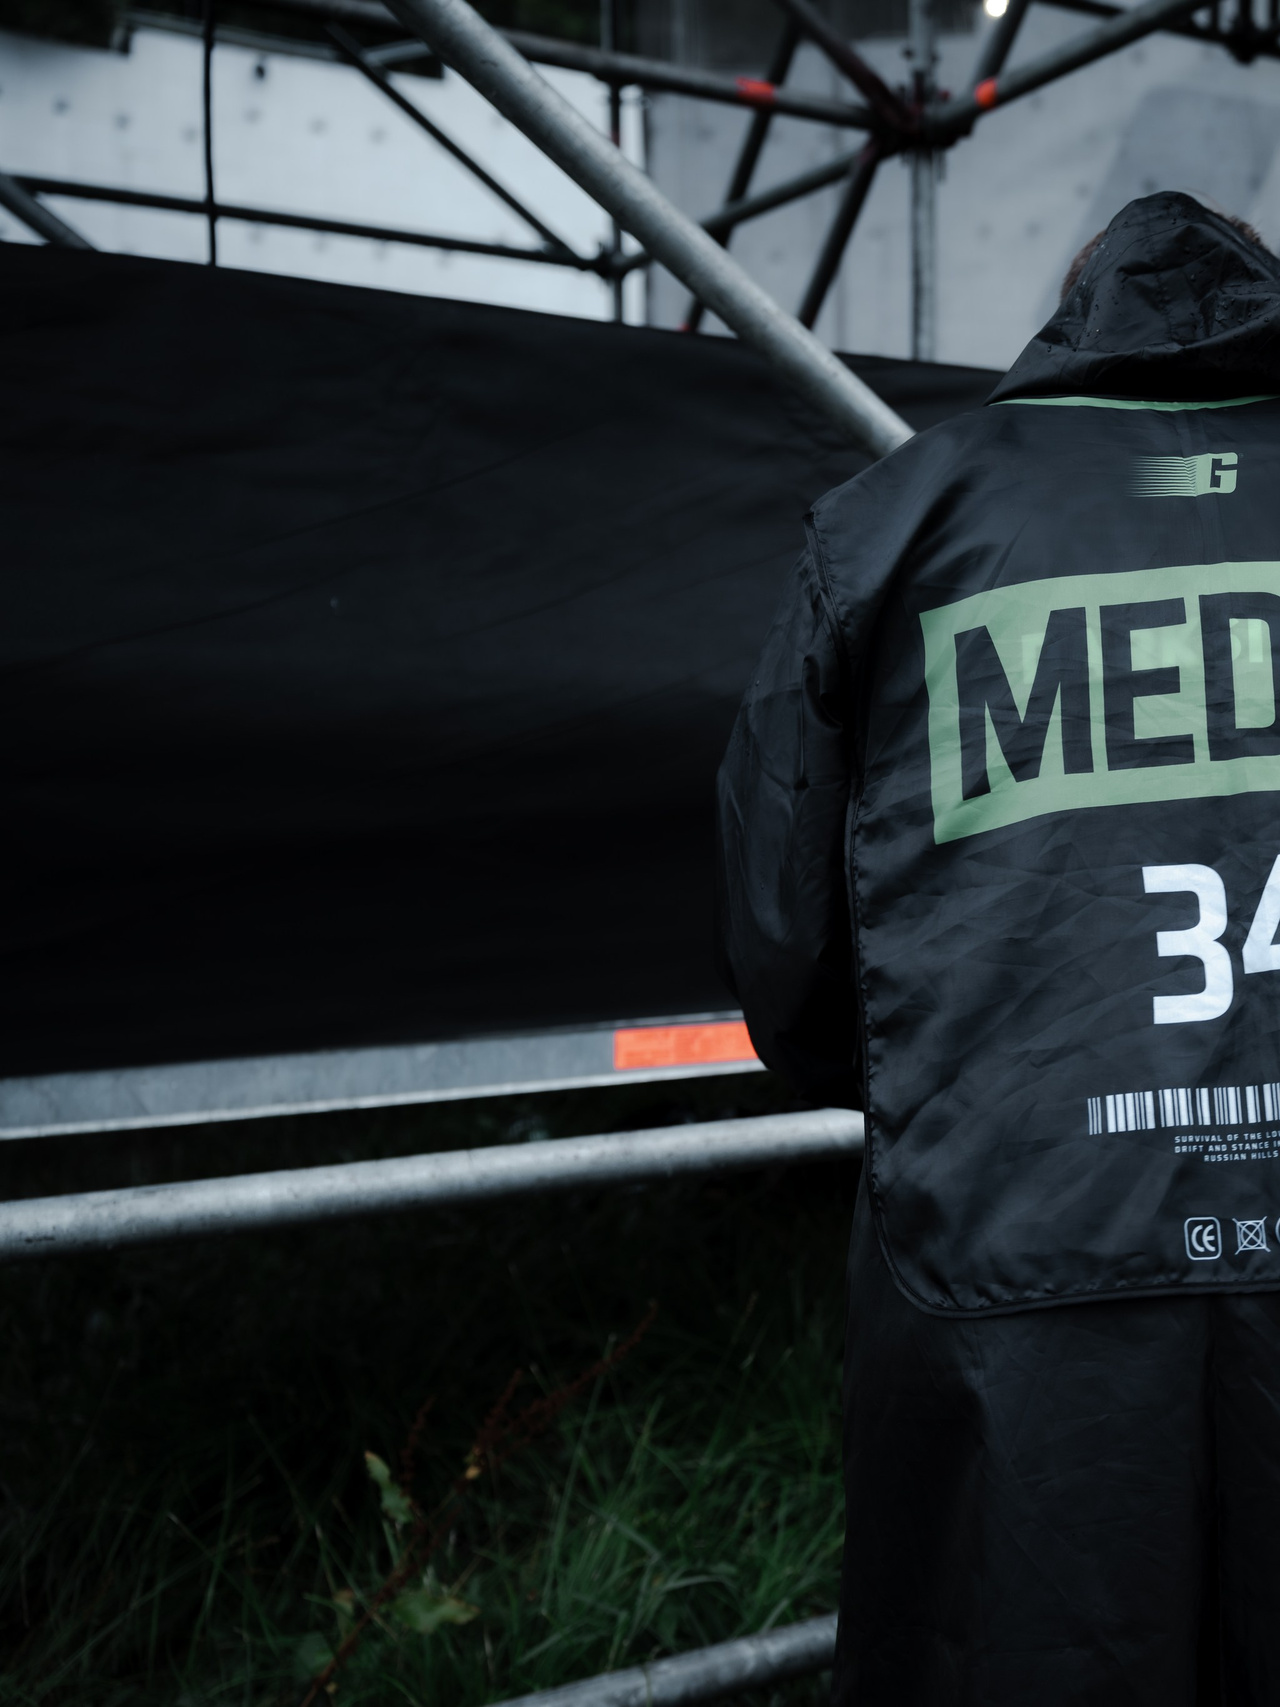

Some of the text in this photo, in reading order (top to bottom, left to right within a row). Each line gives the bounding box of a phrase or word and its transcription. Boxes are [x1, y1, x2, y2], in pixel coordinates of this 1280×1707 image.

[1174, 1134, 1223, 1144] SURVIVAL
[1226, 1133, 1239, 1142] OF
[1243, 1132, 1262, 1141] THE
[1174, 1144, 1204, 1154] DRIFT
[1208, 1144, 1228, 1152] AND
[1231, 1141, 1270, 1152] STANCE
[1203, 1149, 1279, 1162] RUSSIAN HILLS
